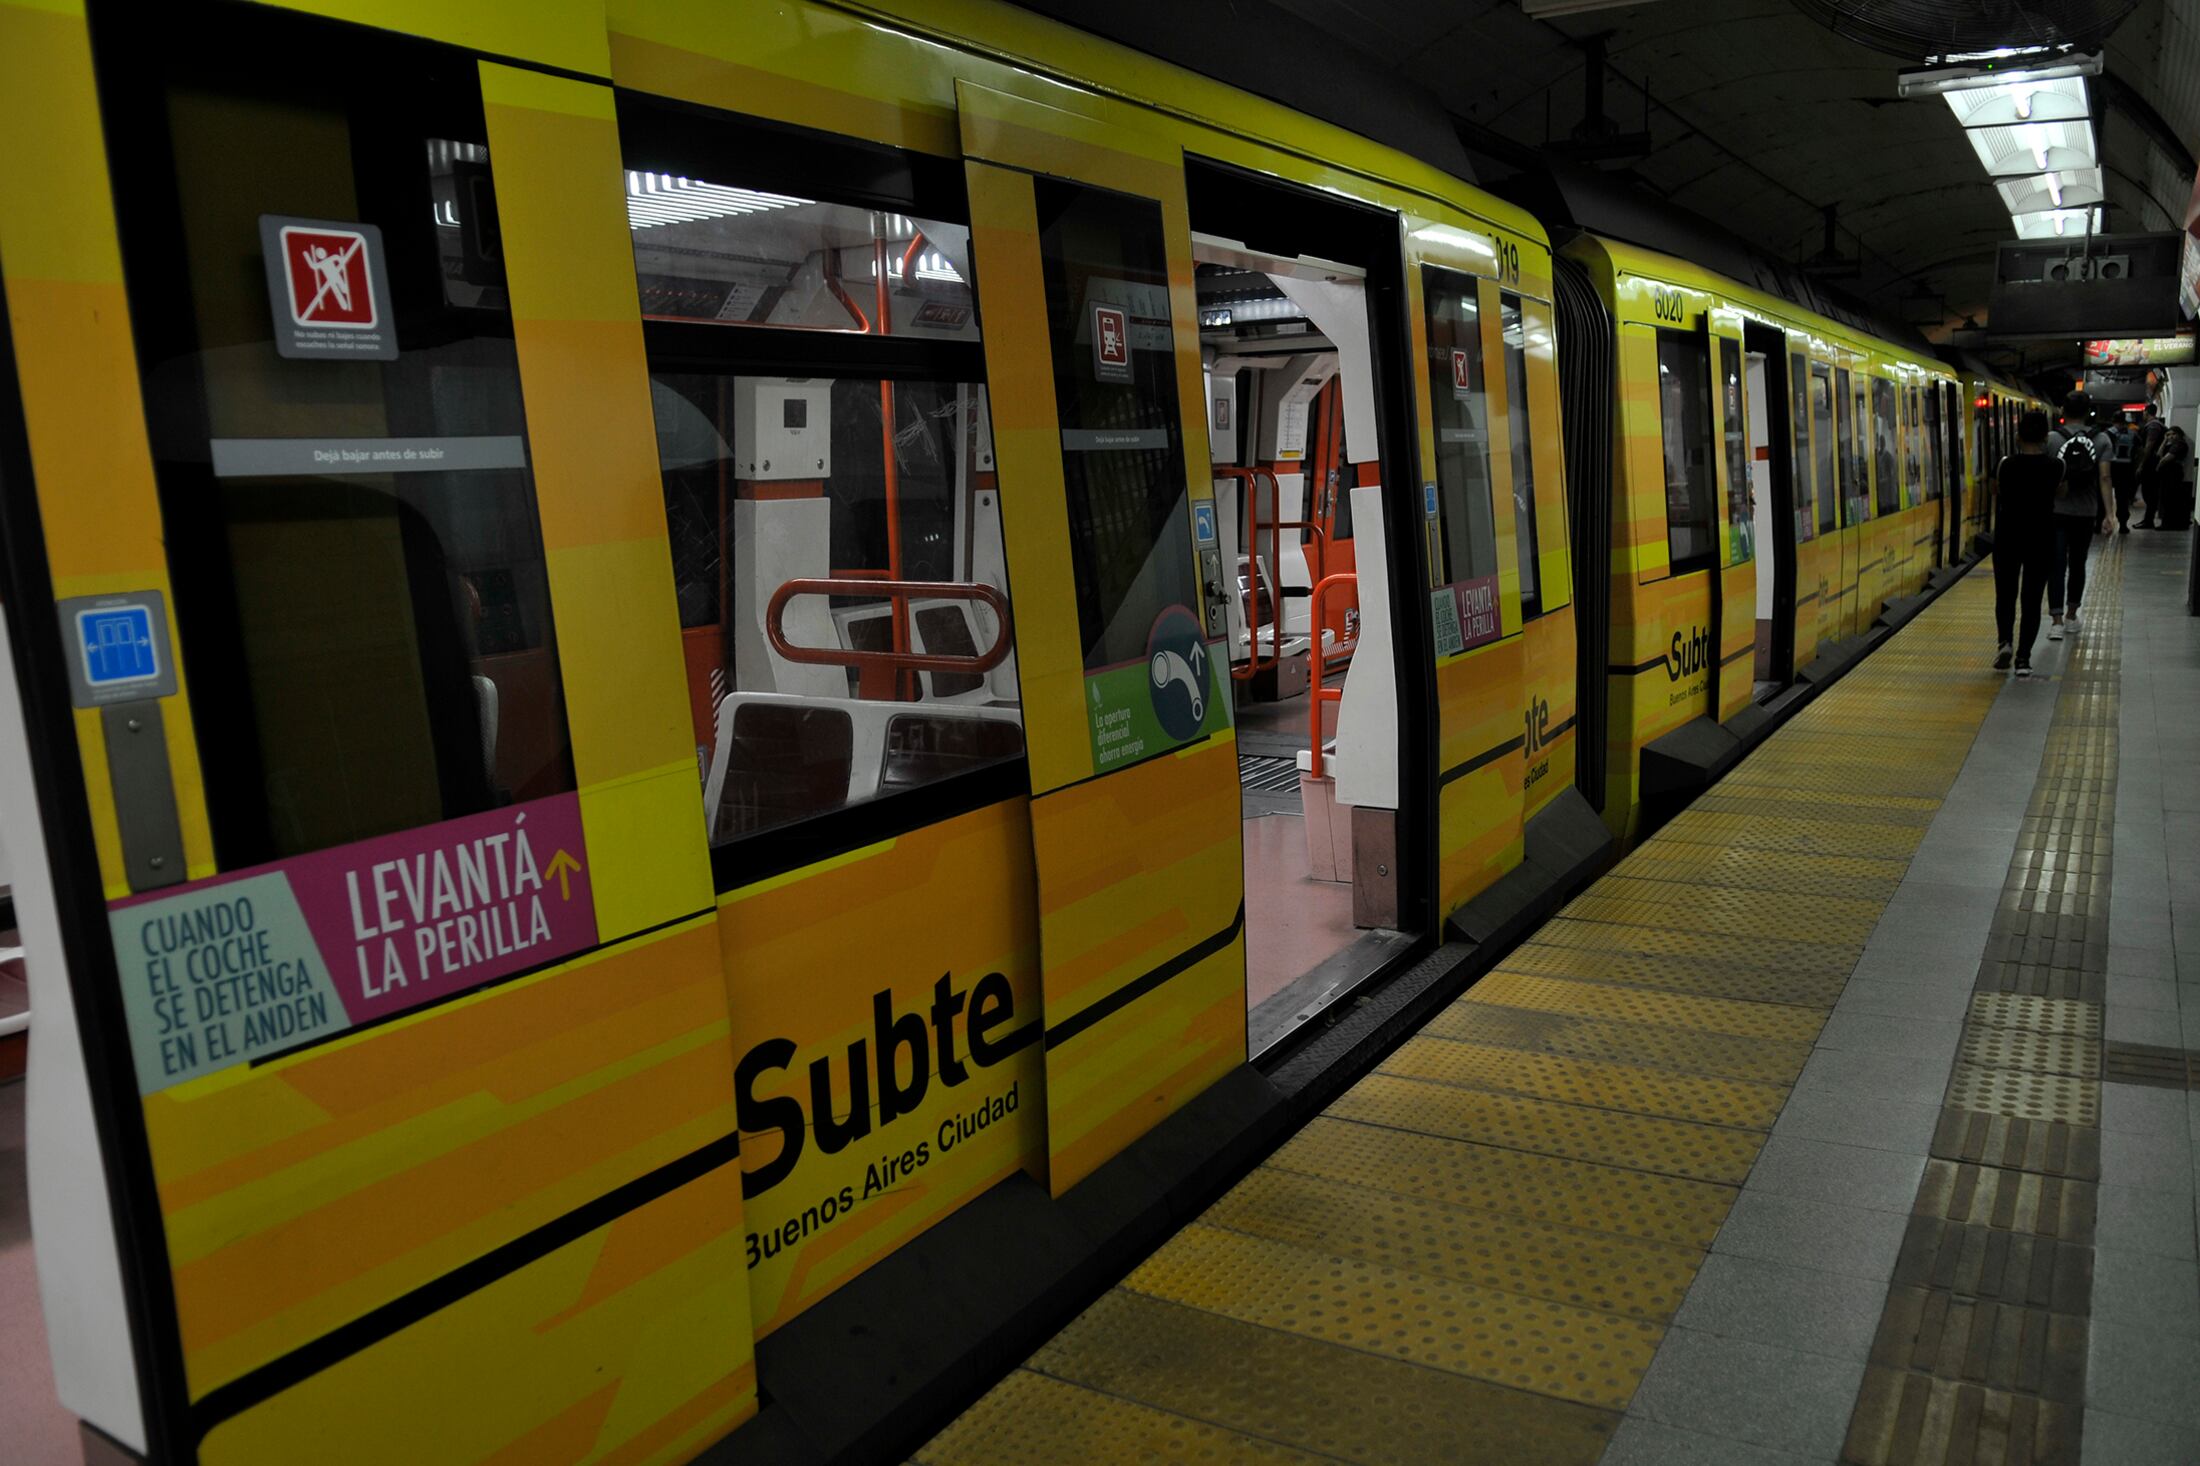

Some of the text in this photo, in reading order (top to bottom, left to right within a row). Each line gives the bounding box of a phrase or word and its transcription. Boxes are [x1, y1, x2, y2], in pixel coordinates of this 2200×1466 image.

[1488, 232, 1519, 286] 019
[1654, 287, 1683, 323] 6020
[342, 449, 370, 463] bajar
[372, 449, 401, 460] antes
[403, 449, 417, 460] de
[419, 448, 444, 459] subir
[1463, 612, 1495, 640] LA PERILLA
[346, 812, 543, 942] LEVANTÁ
[142, 897, 254, 957] CUANDO
[356, 895, 552, 999] LA PERILLA
[147, 930, 272, 998] EL COCHE
[154, 958, 313, 1034] SE DETENGA
[160, 992, 327, 1076] EN EL ANDEN
[734, 970, 1014, 1201] Subte
[745, 1080, 1019, 1270] Buenos Aires Ciudad
